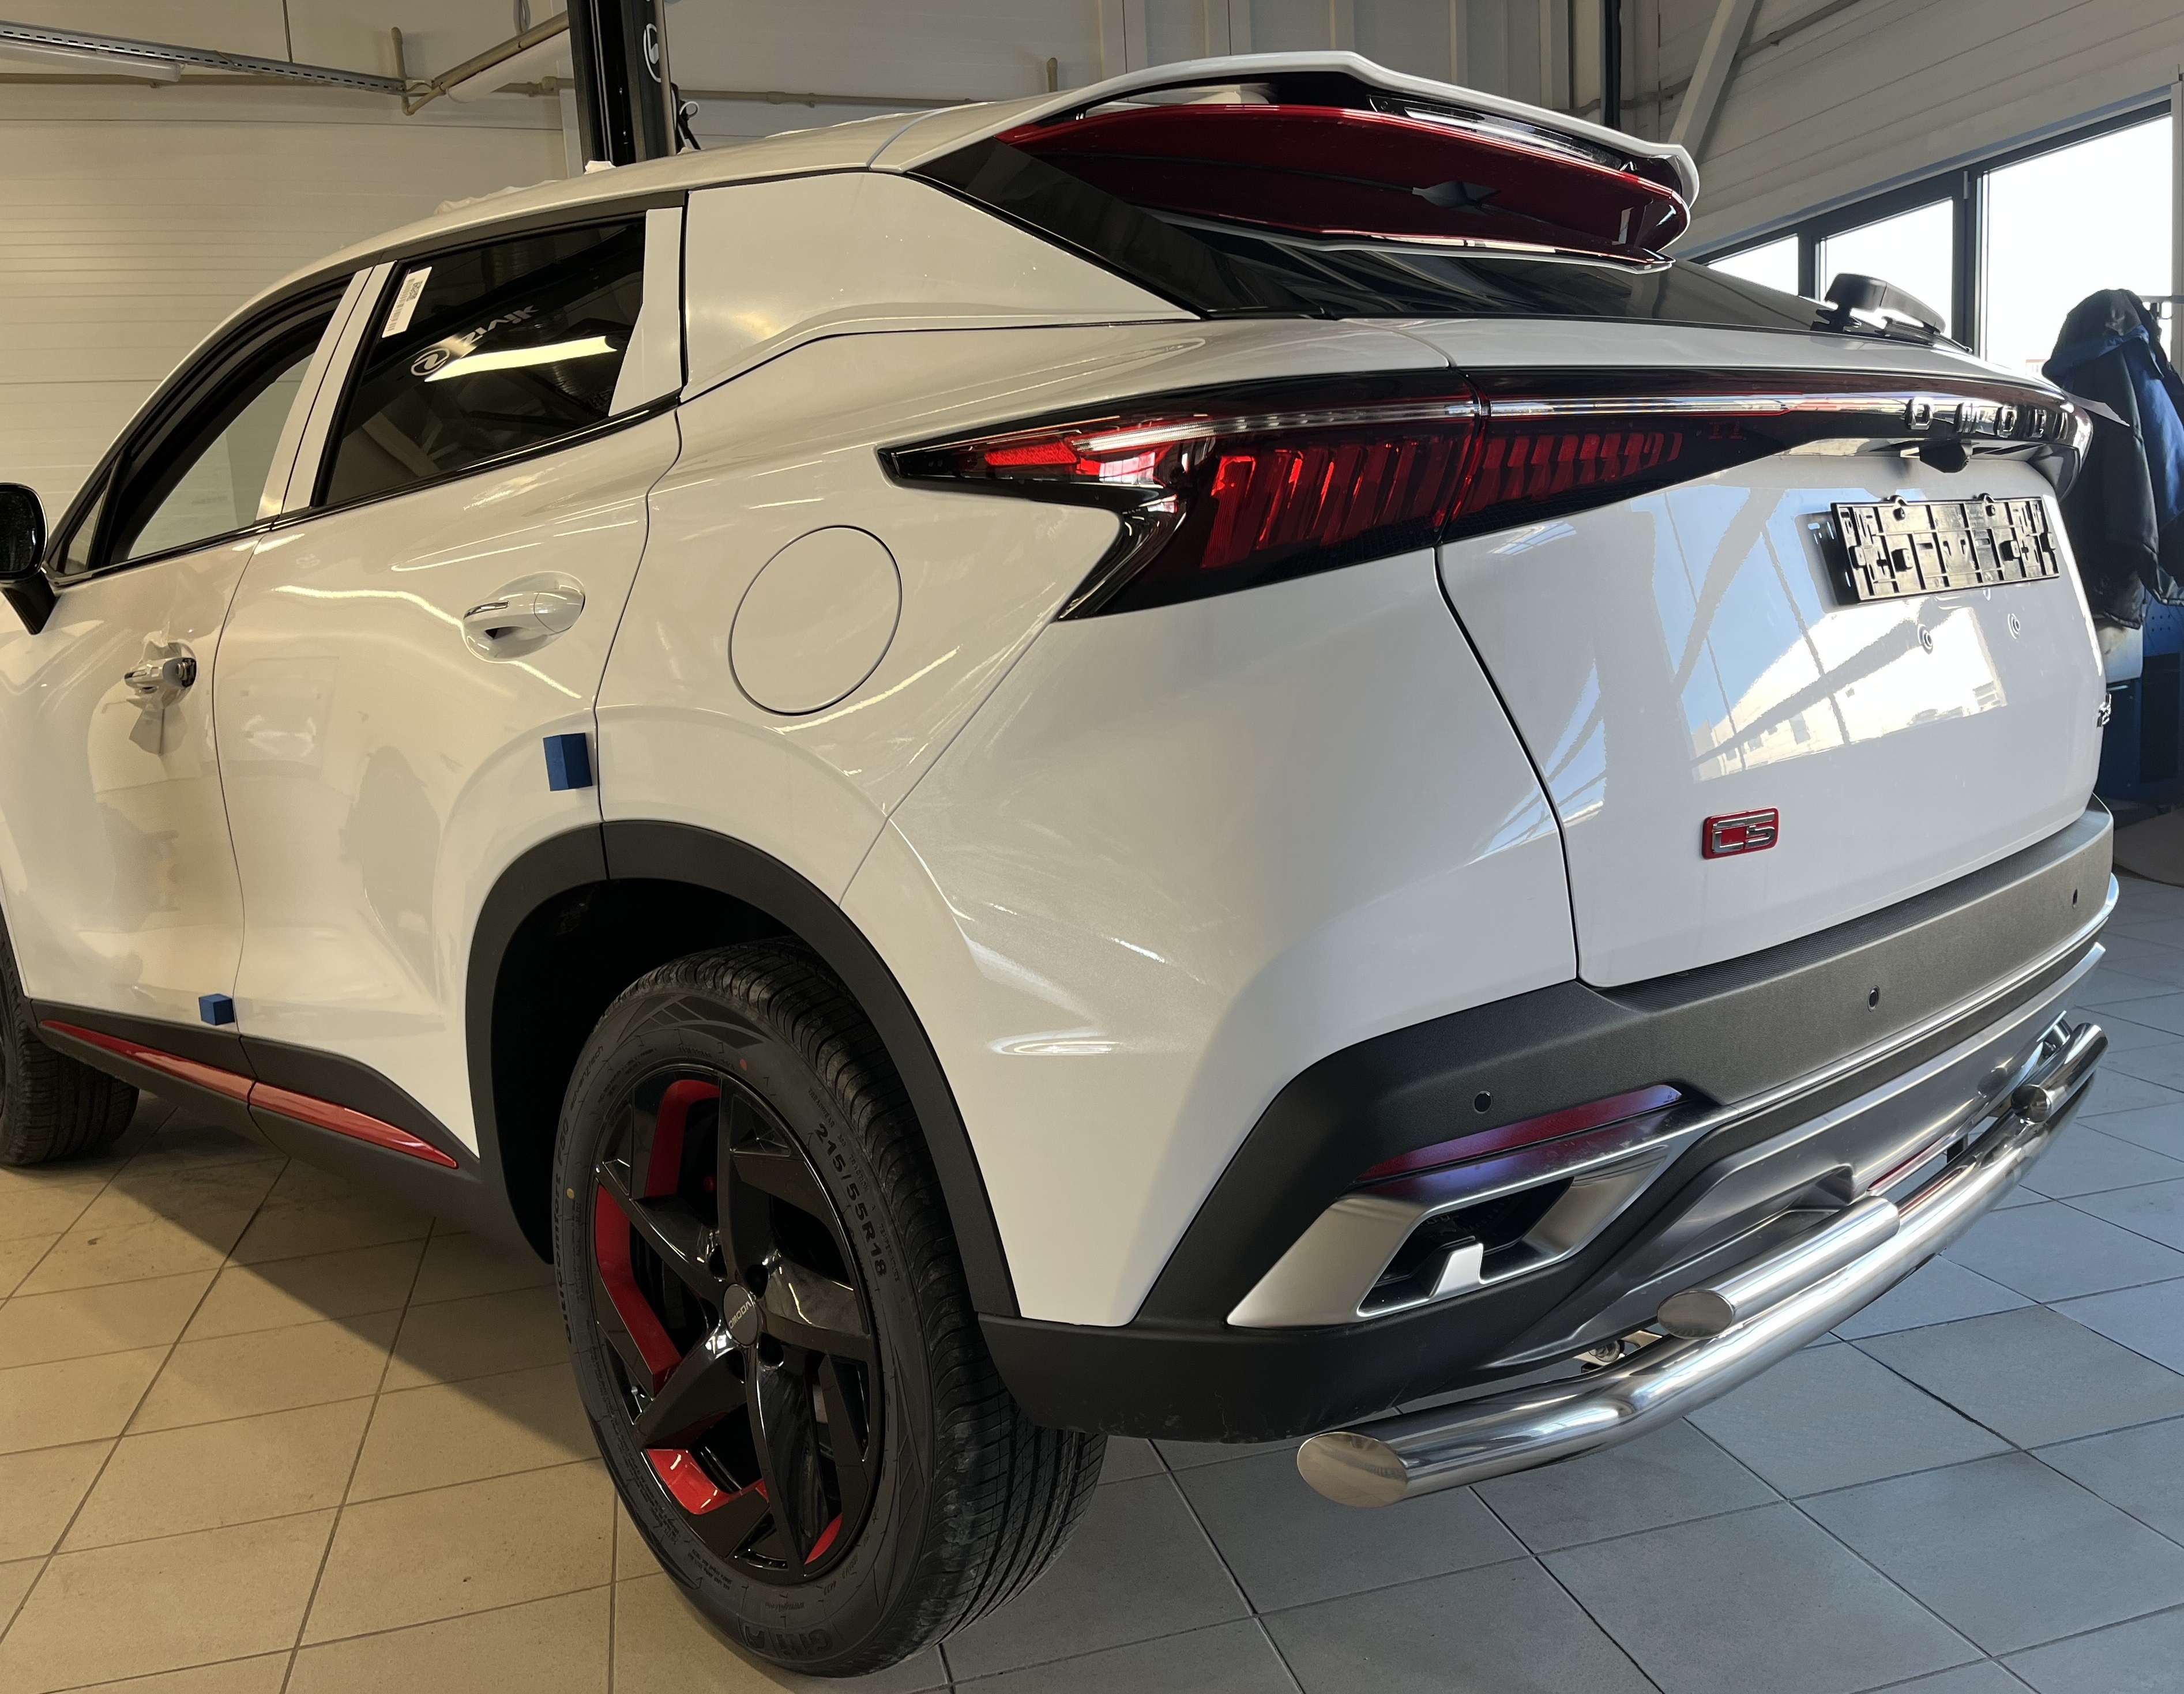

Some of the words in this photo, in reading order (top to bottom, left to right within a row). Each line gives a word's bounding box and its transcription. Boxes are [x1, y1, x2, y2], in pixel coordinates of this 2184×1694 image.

[1712, 811, 1776, 854] C5
[556, 1116, 570, 1166] F50
[807, 1086, 834, 1129] TREADWEAR
[848, 1153, 869, 1192] TRACTION
[878, 1223, 900, 1282] TEMPERATURE
[813, 1119, 889, 1277] 215/55R18
[728, 1301, 751, 1329] OMODA
